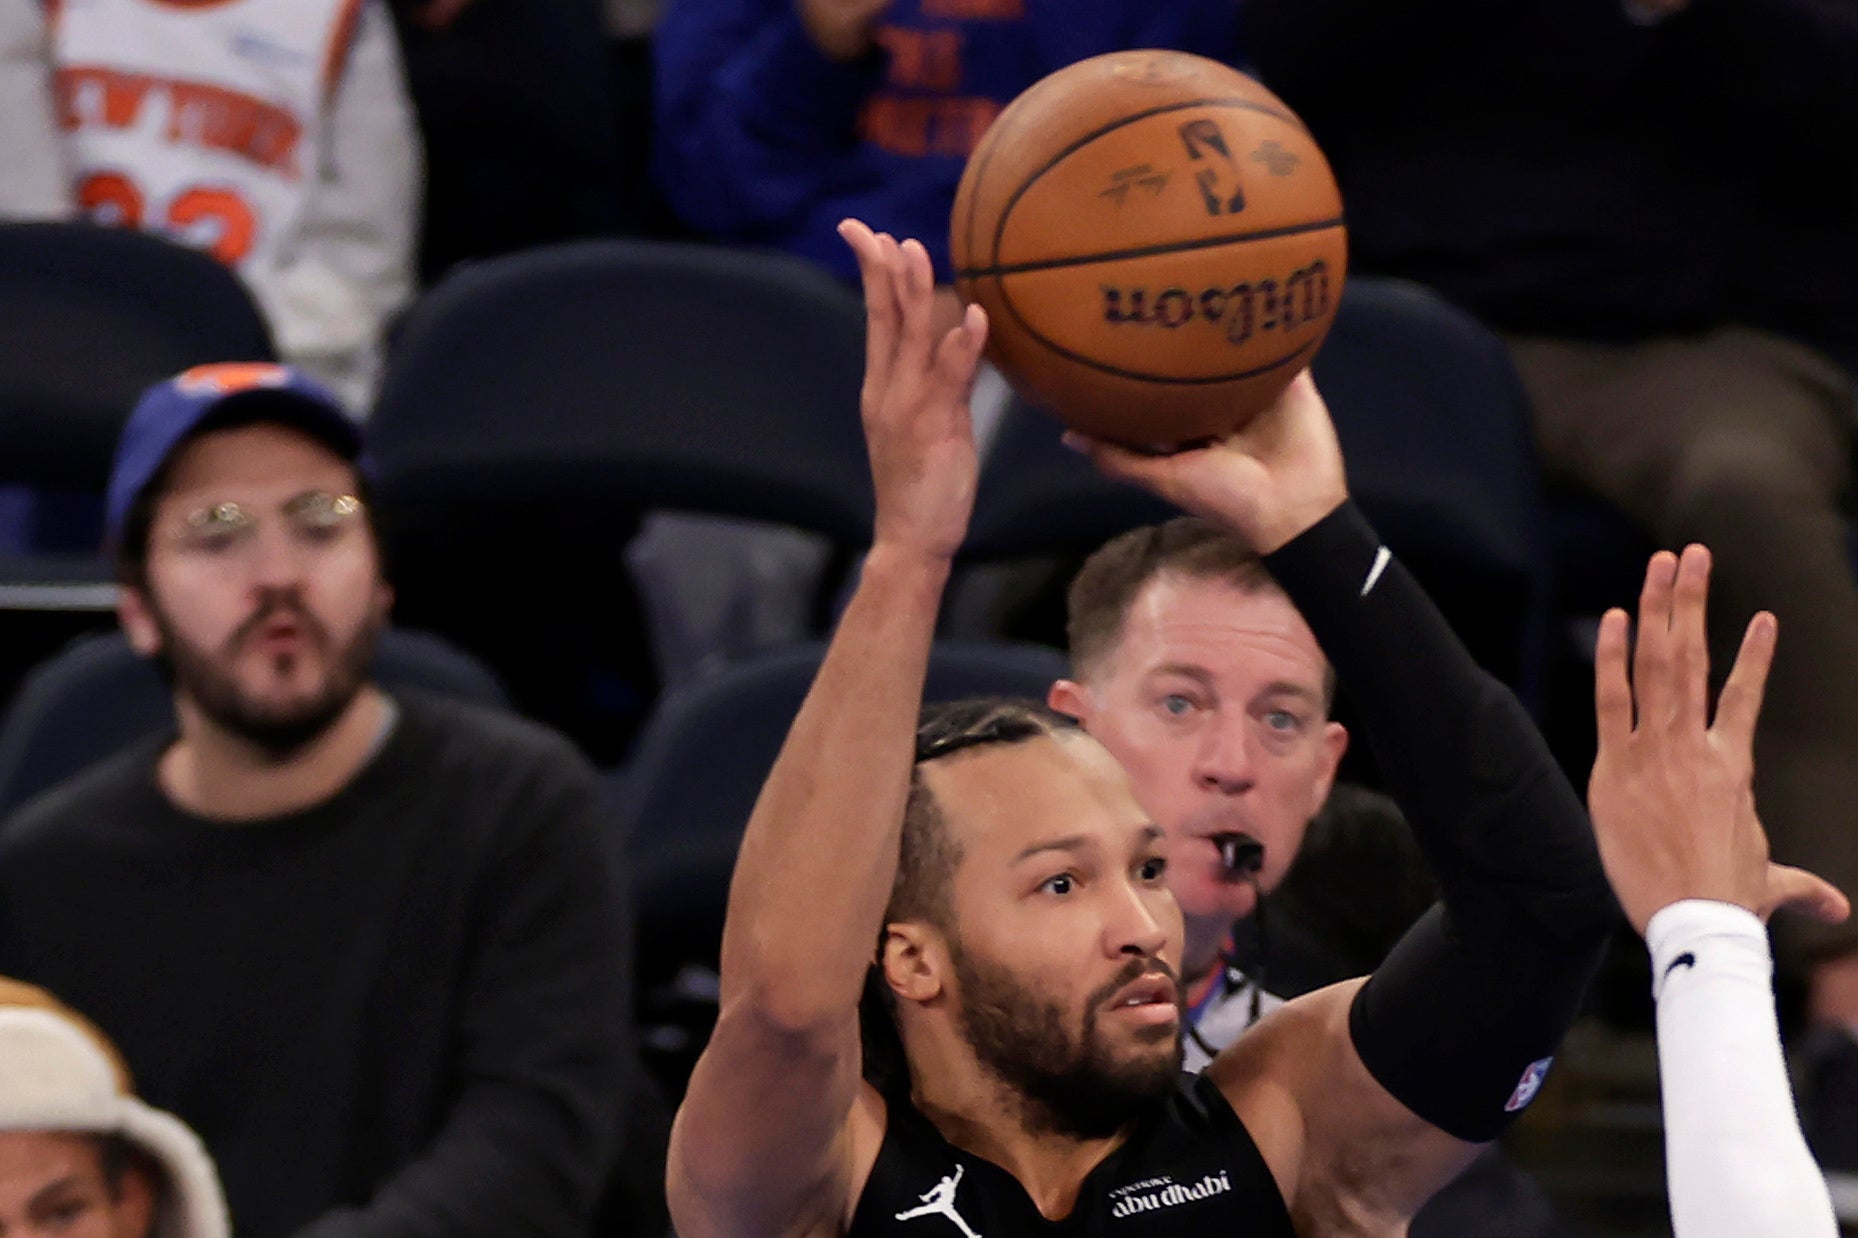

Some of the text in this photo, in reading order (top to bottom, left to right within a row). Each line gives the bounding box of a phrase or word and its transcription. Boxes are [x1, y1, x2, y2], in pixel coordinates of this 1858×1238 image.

[1101, 260, 1329, 344] Wilson
[1112, 1169, 1231, 1218] abu dhabi
